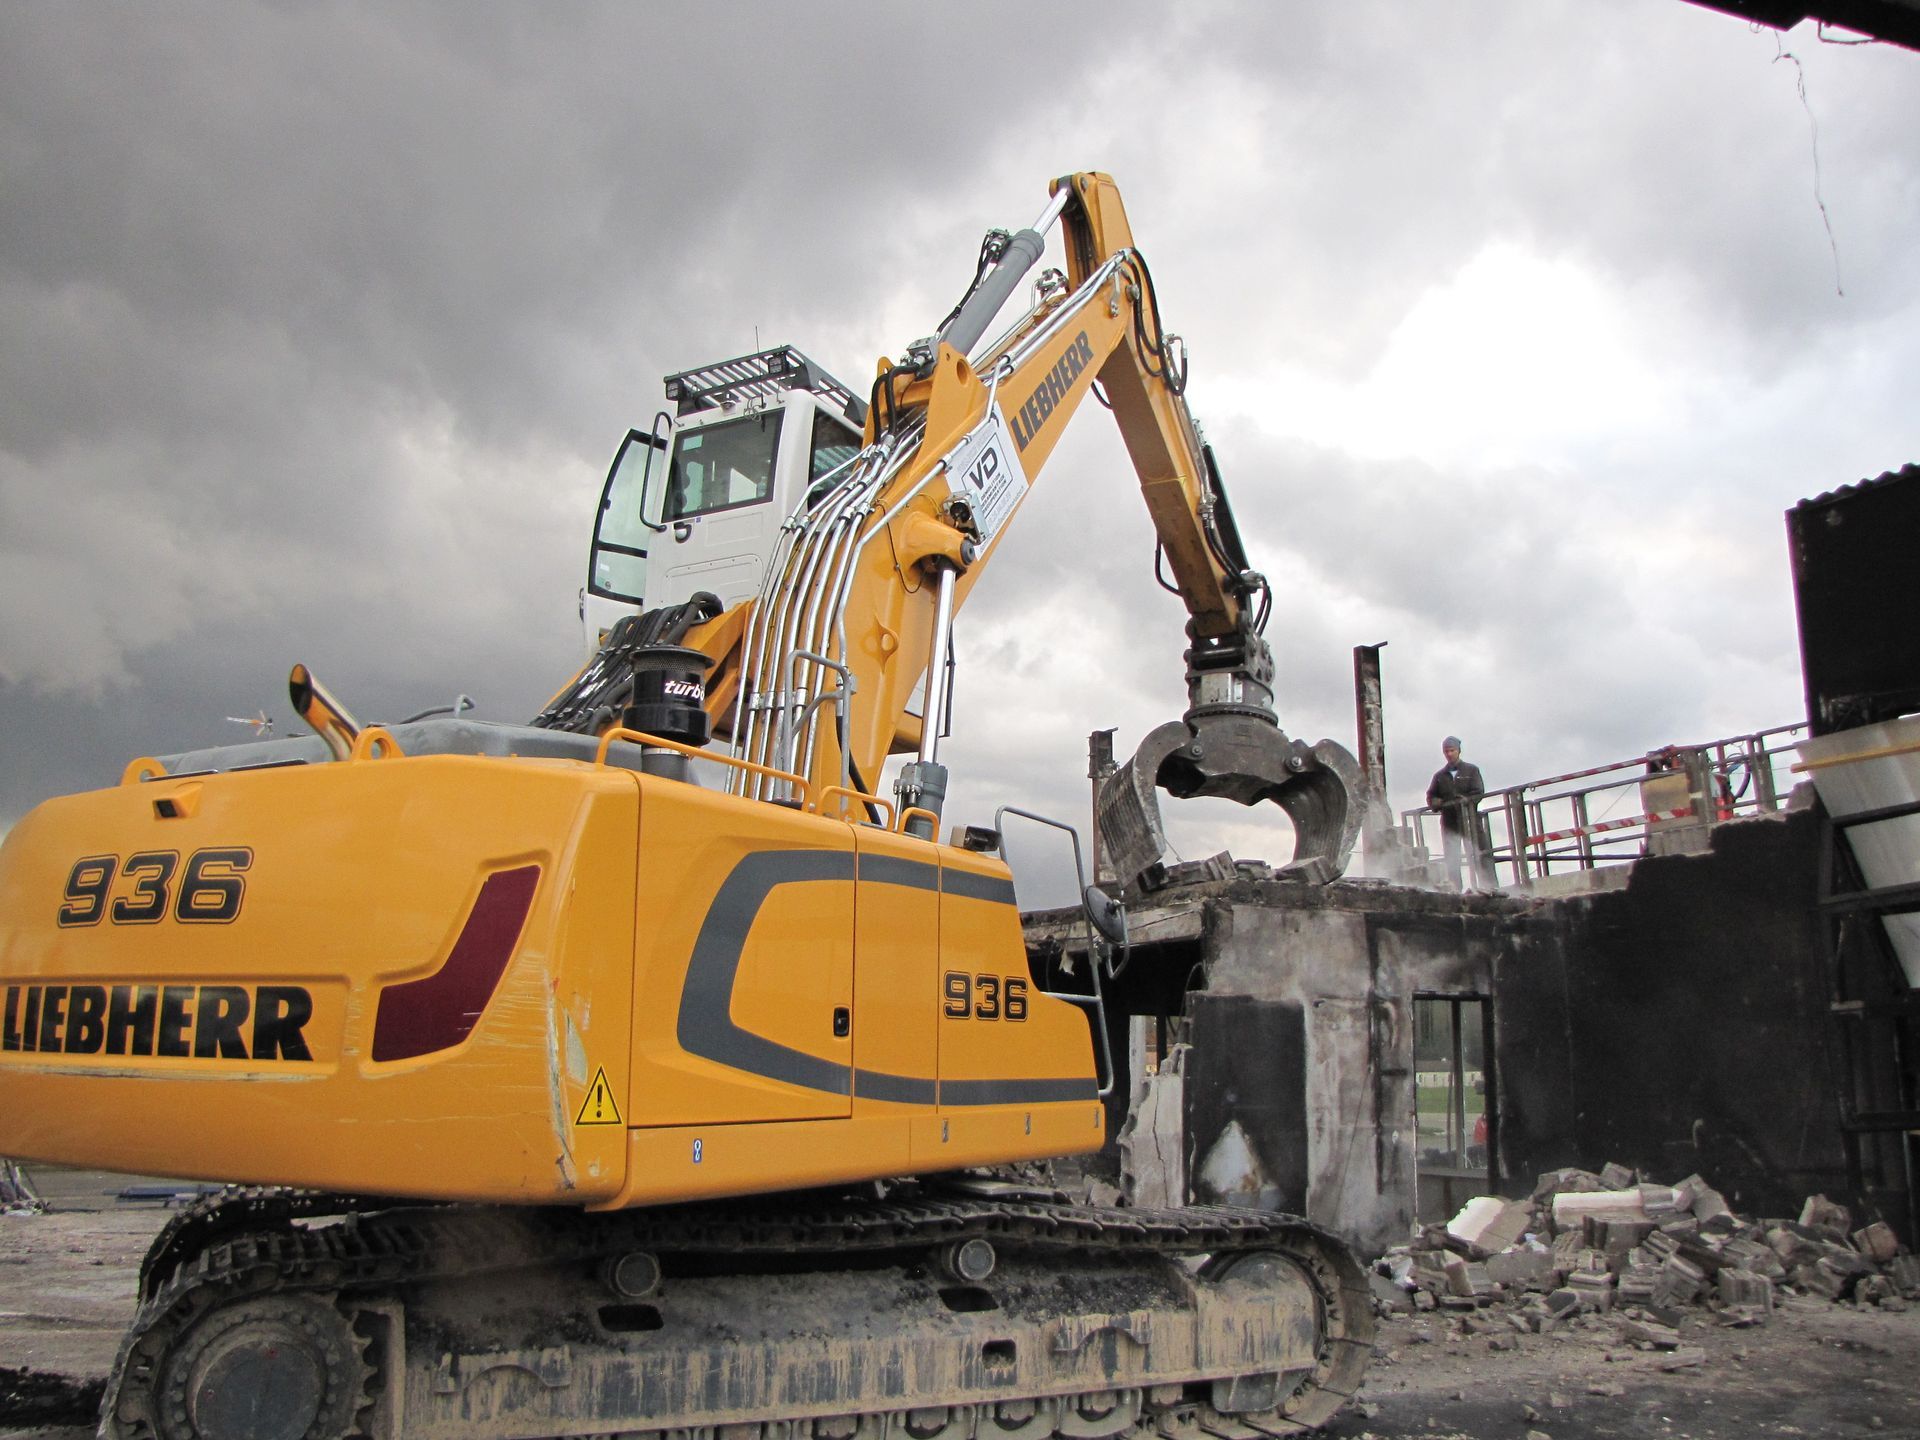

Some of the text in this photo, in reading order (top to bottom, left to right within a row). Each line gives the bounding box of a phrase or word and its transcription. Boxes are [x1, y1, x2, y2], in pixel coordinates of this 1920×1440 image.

[1010, 330, 1094, 453] LIEBHERR
[969, 447, 999, 490] VD
[664, 680, 705, 701] turbo
[57, 846, 254, 928] 936
[2, 985, 313, 1061] LIEBHERR
[943, 970, 1028, 1022] 936
